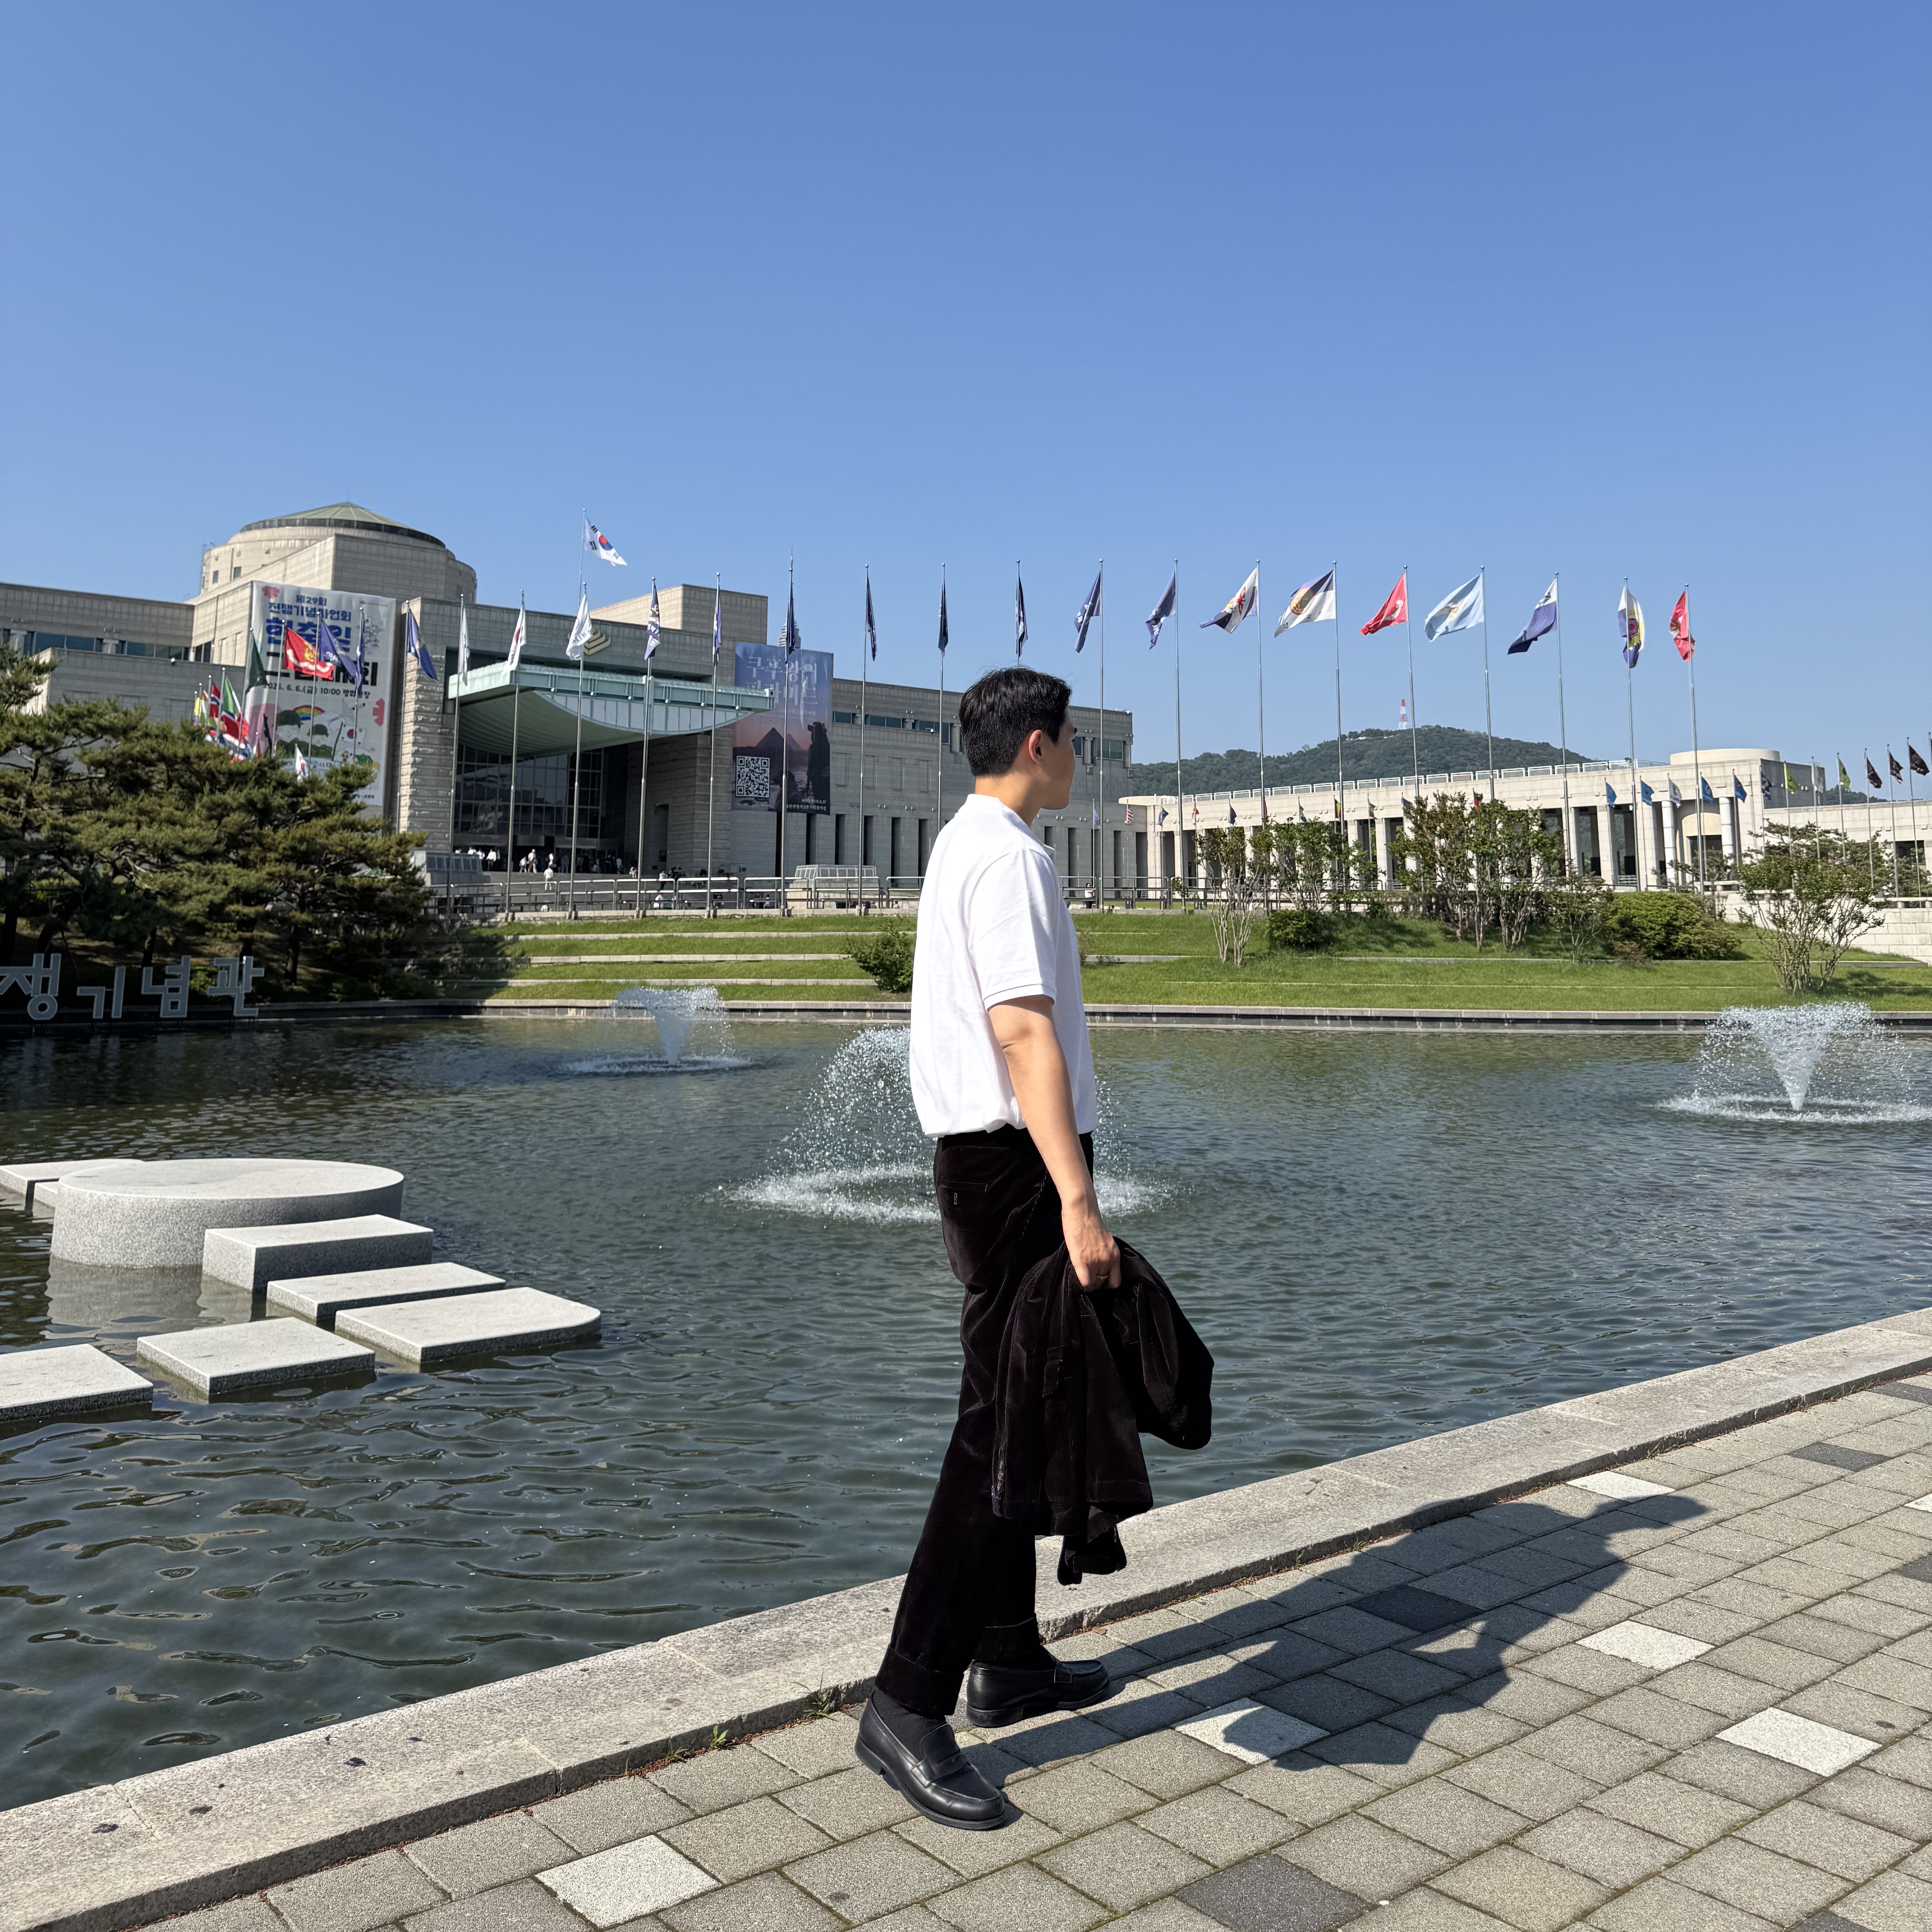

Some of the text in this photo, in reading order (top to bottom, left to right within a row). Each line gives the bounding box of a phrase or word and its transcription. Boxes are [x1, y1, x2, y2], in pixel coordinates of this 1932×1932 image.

[296, 595, 327, 606] 제29회
[269, 603, 351, 621] 전쟁기념사업회
[747, 656, 817, 684] 쿠푸왕의
[321, 687, 341, 695] 10:00
